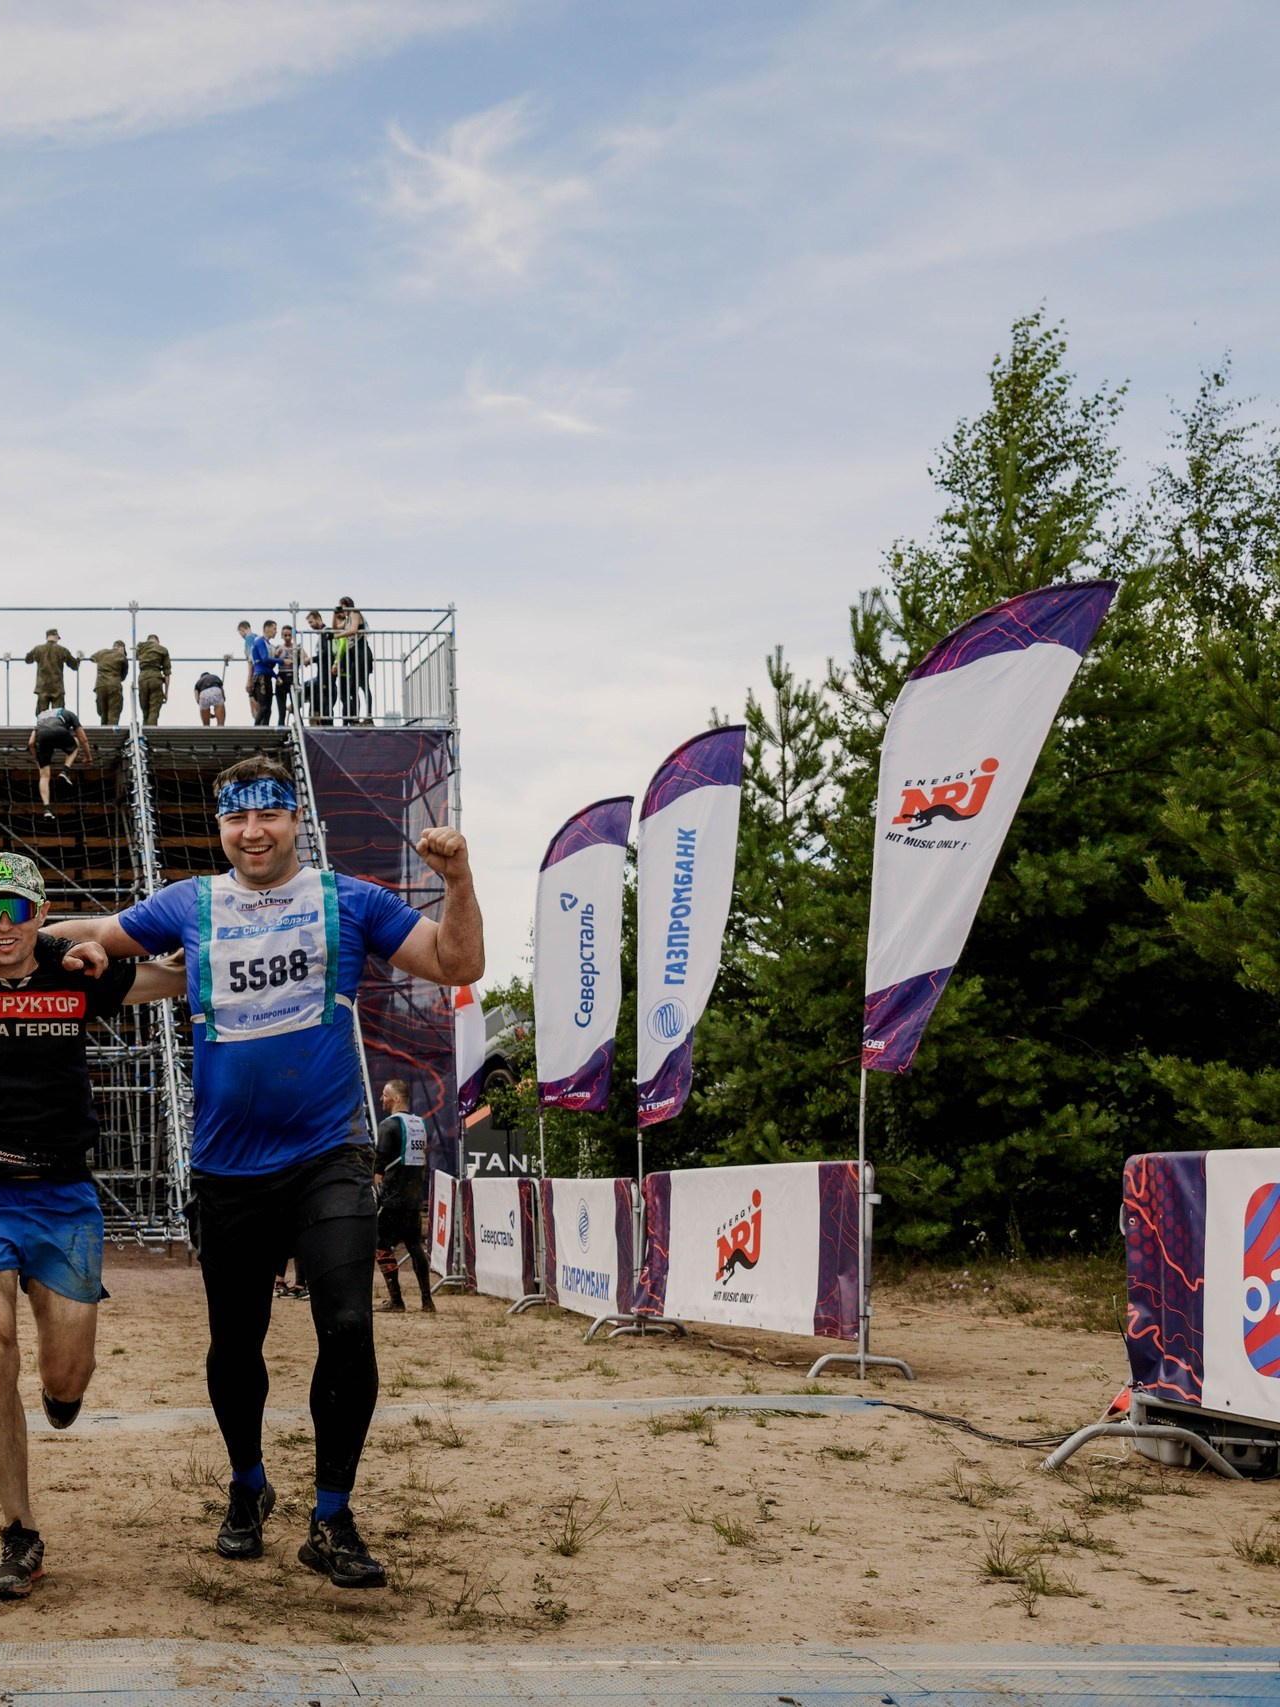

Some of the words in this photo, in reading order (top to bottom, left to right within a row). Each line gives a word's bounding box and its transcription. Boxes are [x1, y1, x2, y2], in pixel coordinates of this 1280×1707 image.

[904, 769, 976, 787] ENERGY
[885, 832, 904, 843] HIT
[903, 836, 936, 849] MUSIC
[936, 840, 960, 849] ONLY
[663, 827, 697, 985] ГАЗПРОМБАНК
[229, 949, 309, 994] 5588
[574, 903, 600, 1029] Северсталь
[252, 1004, 301, 1022] ГАЗПРОМБАНК
[15, 1022, 80, 1037] ГЕРОЕВ
[717, 1204, 752, 1236] ENERGY
[481, 1224, 514, 1250] Северсталь
[562, 1264, 610, 1301] ГАЗПРОМБАНК
